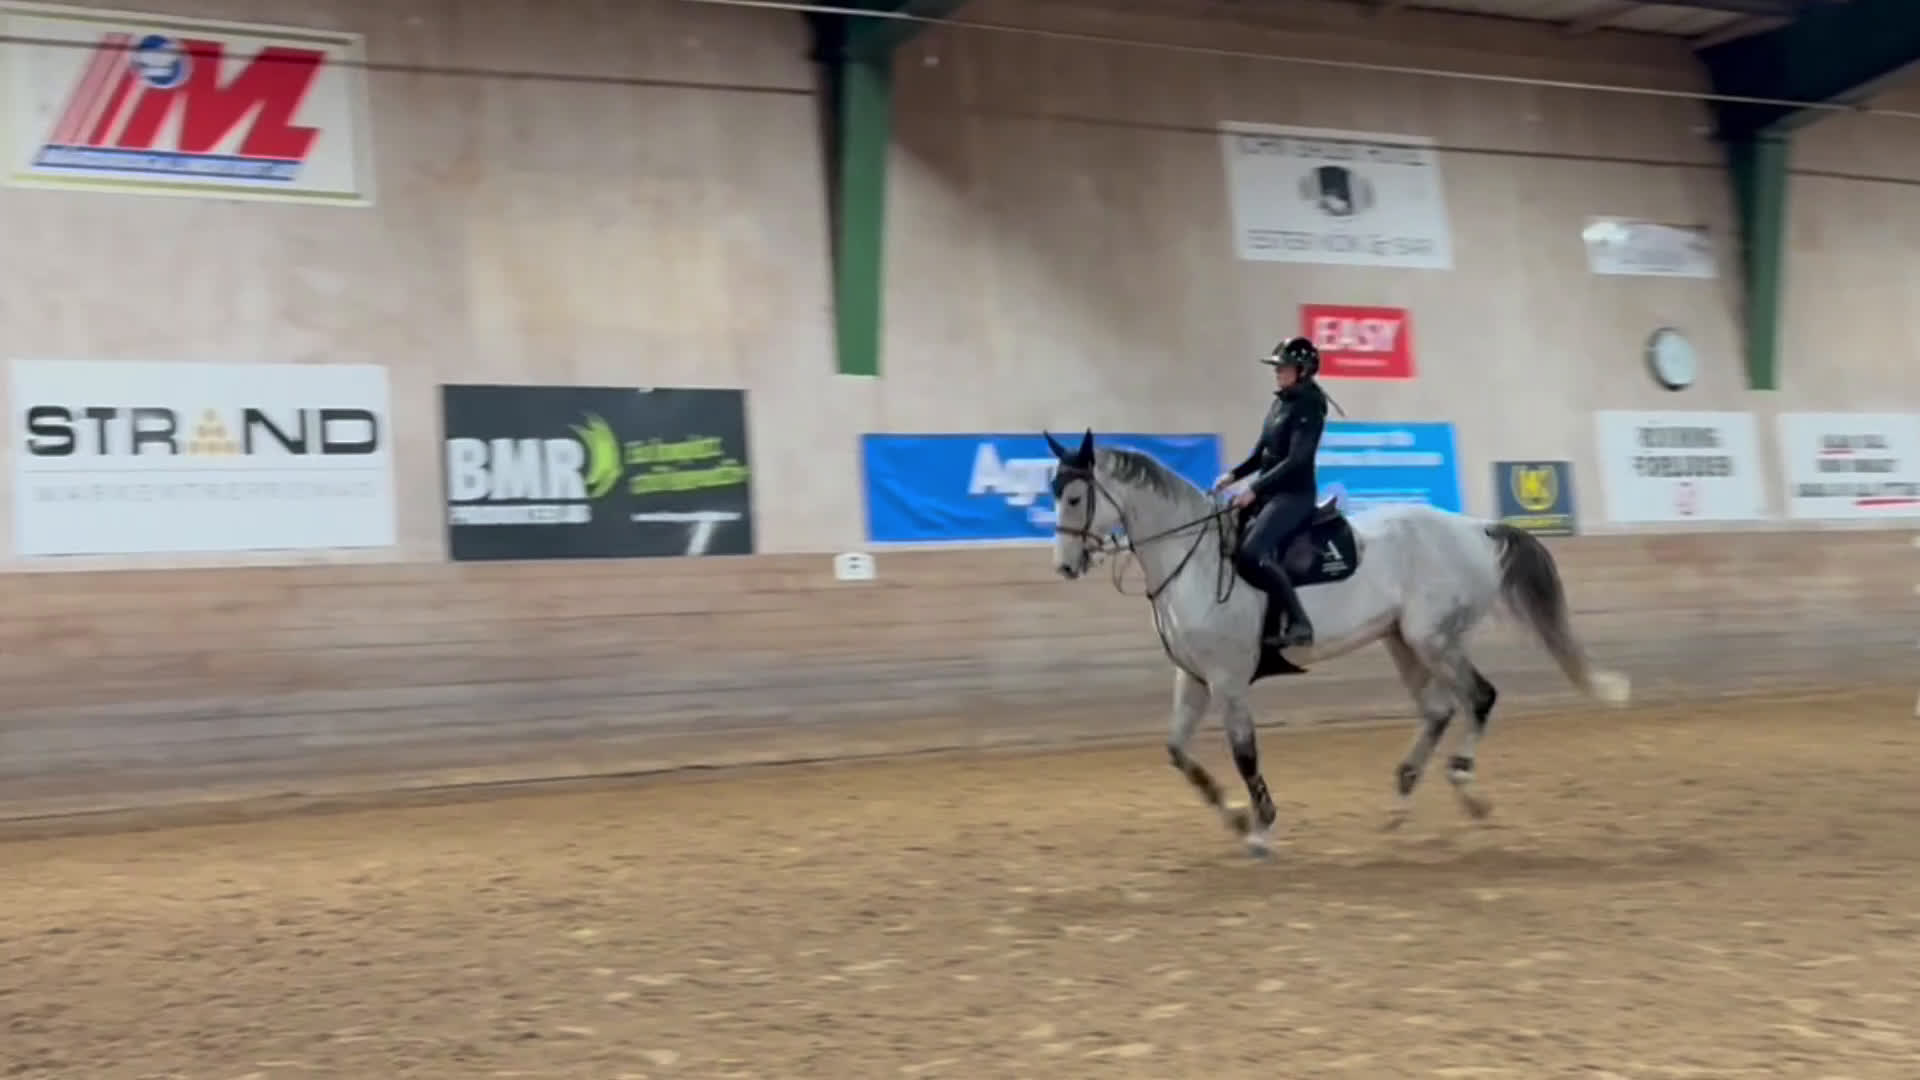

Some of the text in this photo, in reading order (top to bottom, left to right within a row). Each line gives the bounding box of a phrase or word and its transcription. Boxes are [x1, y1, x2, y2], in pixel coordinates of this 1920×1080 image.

[1312, 316, 1401, 352] EASY
[26, 405, 379, 456] STRAND
[447, 438, 586, 501] BMR
[968, 443, 1059, 506] Agr
